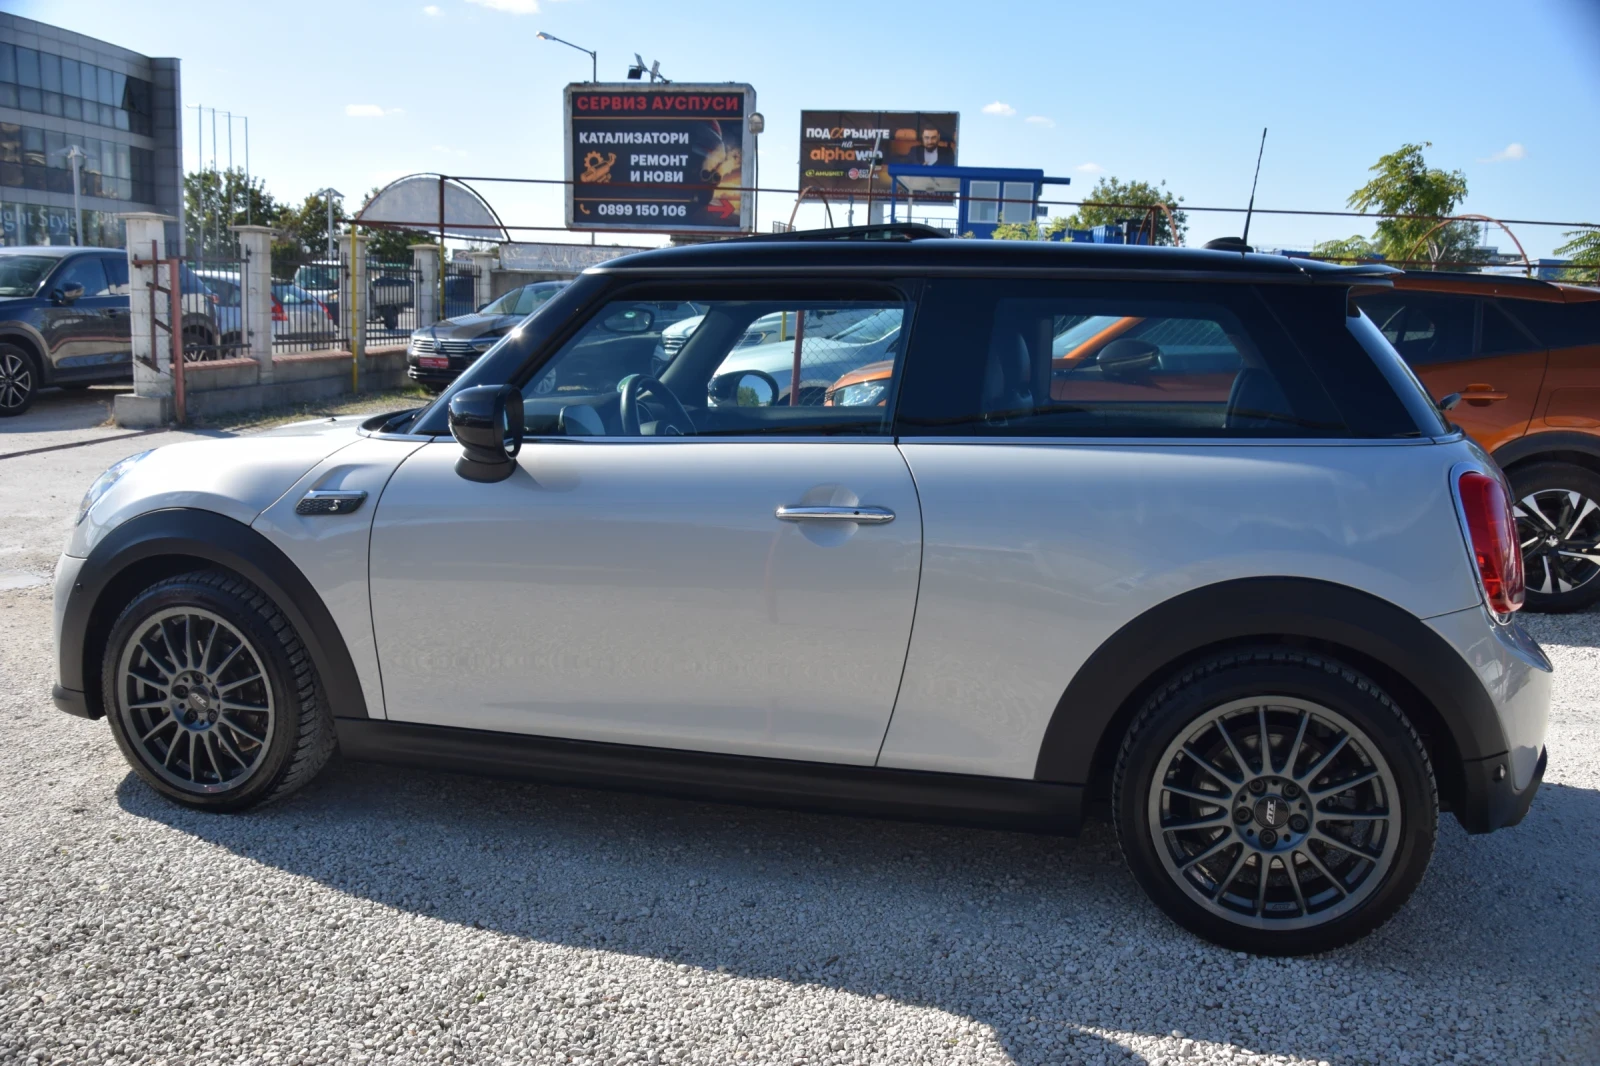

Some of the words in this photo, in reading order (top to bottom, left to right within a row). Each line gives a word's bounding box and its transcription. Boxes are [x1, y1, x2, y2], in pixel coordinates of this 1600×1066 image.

[576, 96, 647, 110] СЕРВИЗ
[652, 96, 738, 111] АУСПУСИ
[579, 132, 689, 144] КАТАЛИЗАТОРИ
[630, 154, 688, 167] РЕМОНТ
[630, 171, 640, 182] И
[643, 171, 683, 183] НОВИ
[598, 204, 633, 216] 0899
[636, 204, 659, 216] 150
[662, 205, 687, 217] 106
